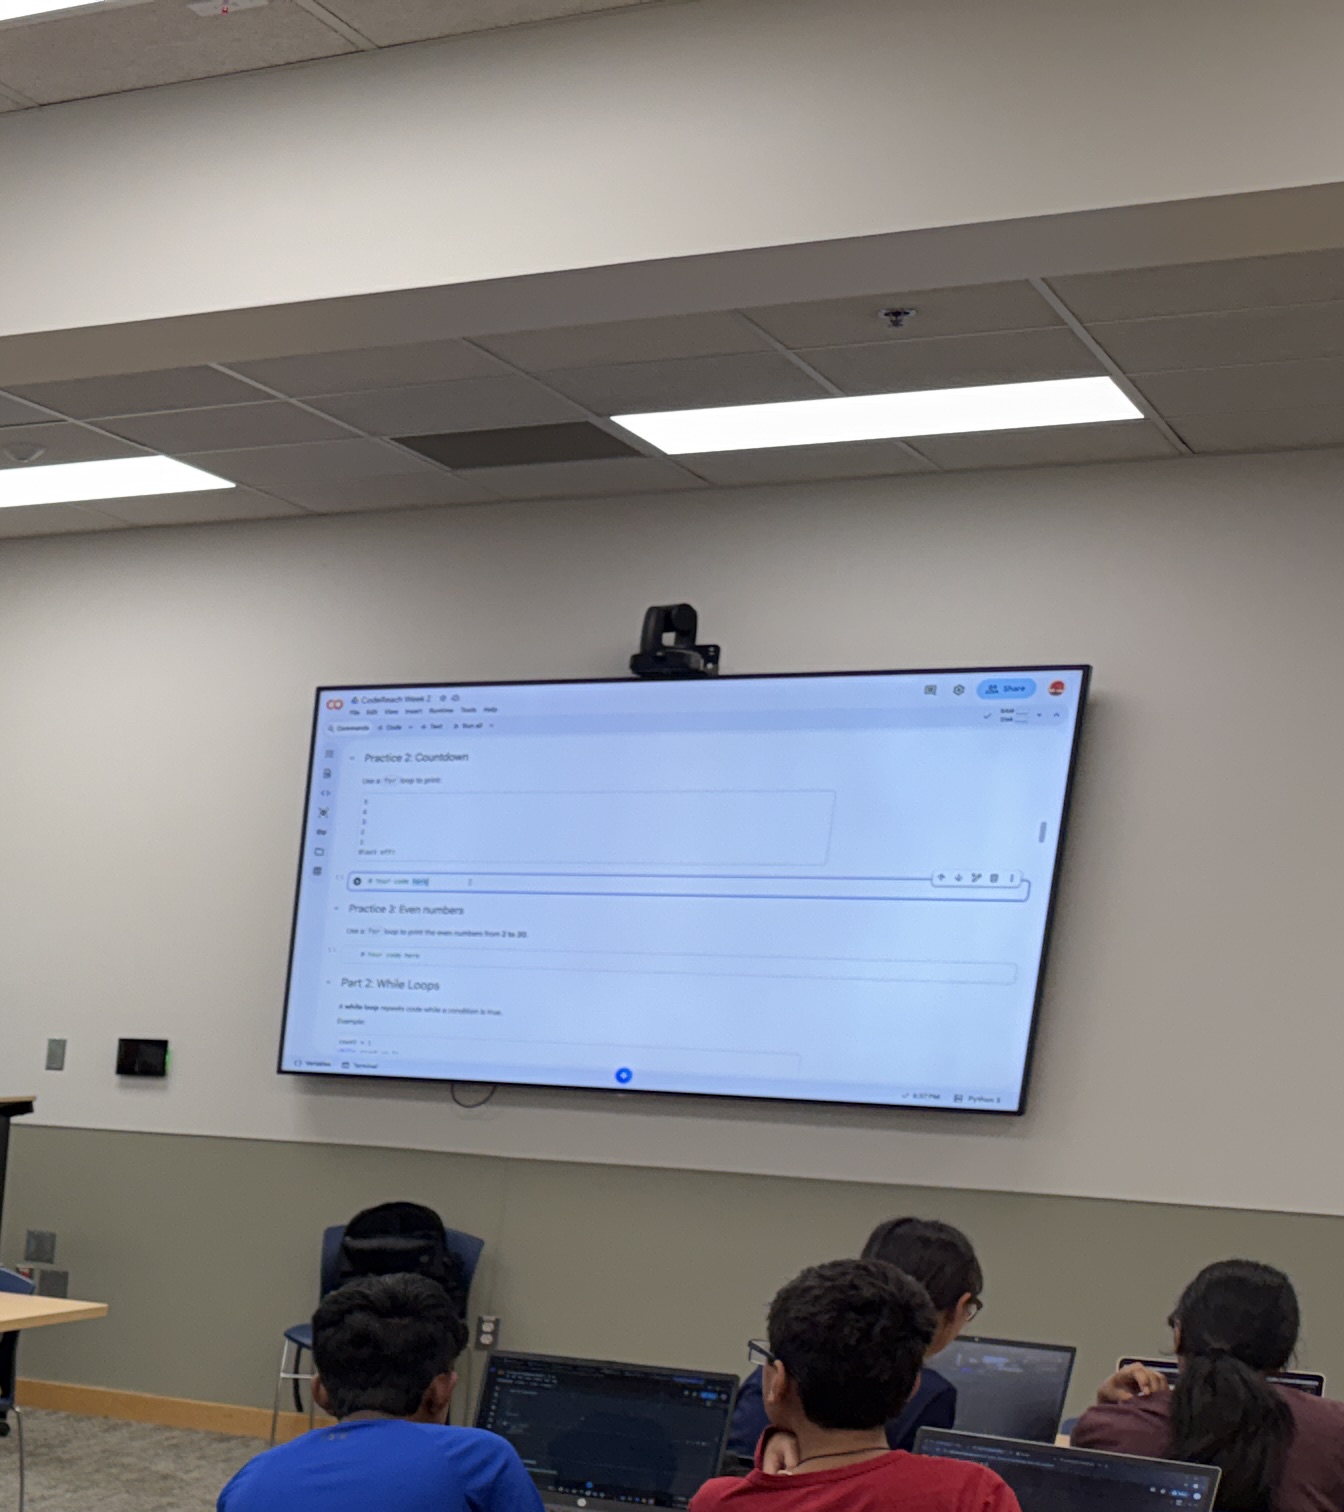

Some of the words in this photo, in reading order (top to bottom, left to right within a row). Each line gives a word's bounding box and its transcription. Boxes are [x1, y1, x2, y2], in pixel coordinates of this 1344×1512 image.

[364, 752, 403, 763] Practice
[404, 752, 413, 763] 2:
[415, 751, 469, 763] Countdown
[348, 903, 386, 915] Practice
[399, 904, 421, 915] Even
[423, 905, 464, 916] numbers
[341, 977, 362, 988] Part
[364, 978, 373, 989] 2:
[377, 979, 405, 990] While
[407, 979, 440, 992] Loops
